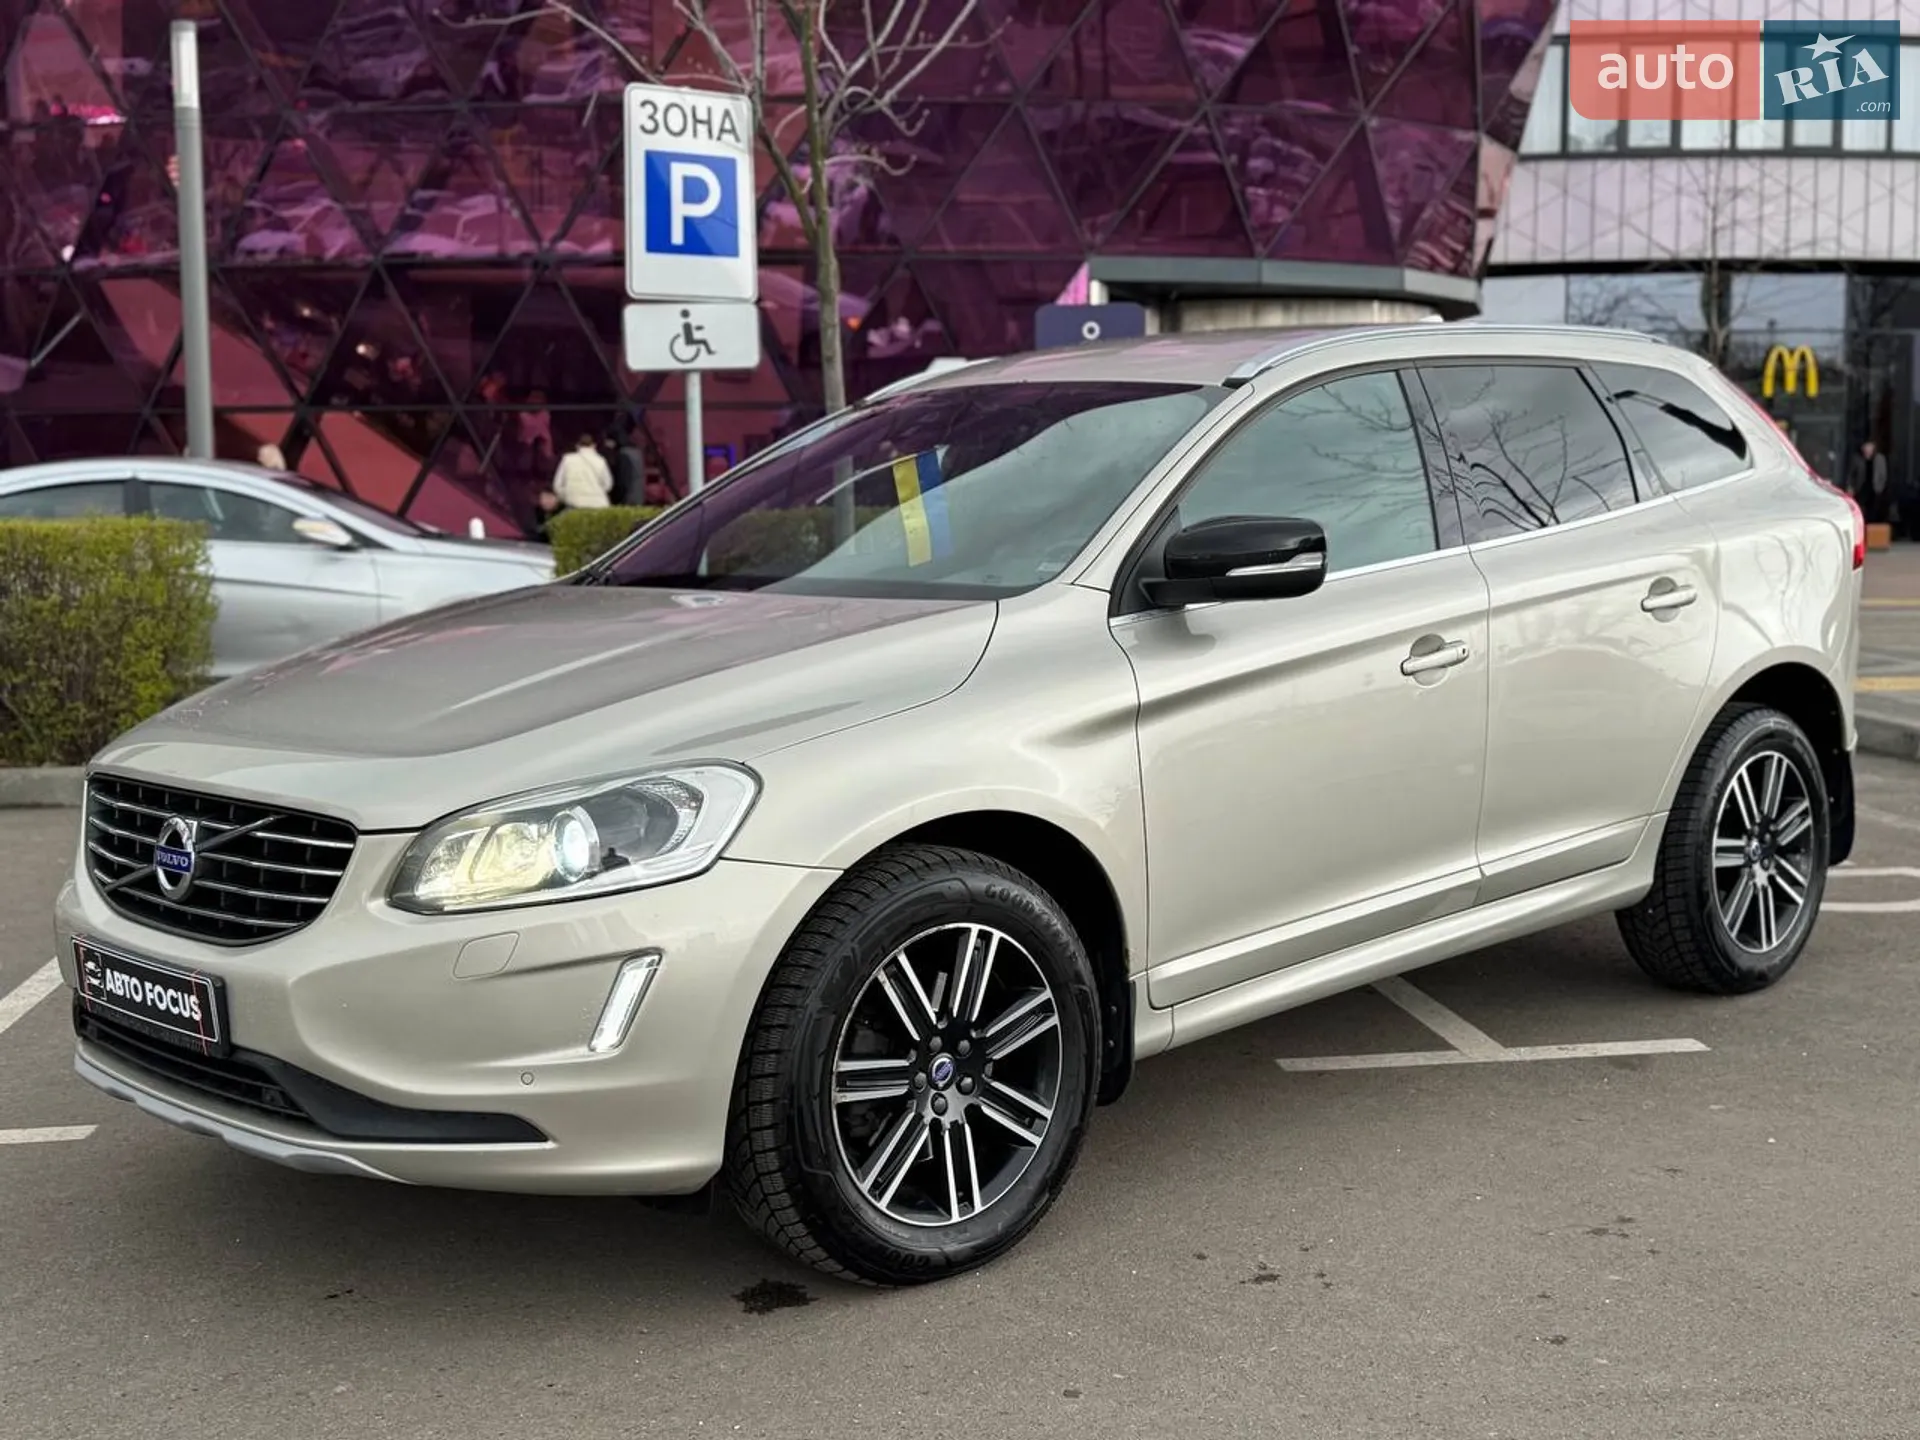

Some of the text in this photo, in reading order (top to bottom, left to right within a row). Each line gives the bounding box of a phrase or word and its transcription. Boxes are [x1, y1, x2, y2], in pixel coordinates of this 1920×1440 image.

[639, 100, 741, 143] ЗОНА
[670, 161, 722, 247] P
[156, 850, 189, 867] VOLVO
[144, 981, 202, 1021] FOCUS
